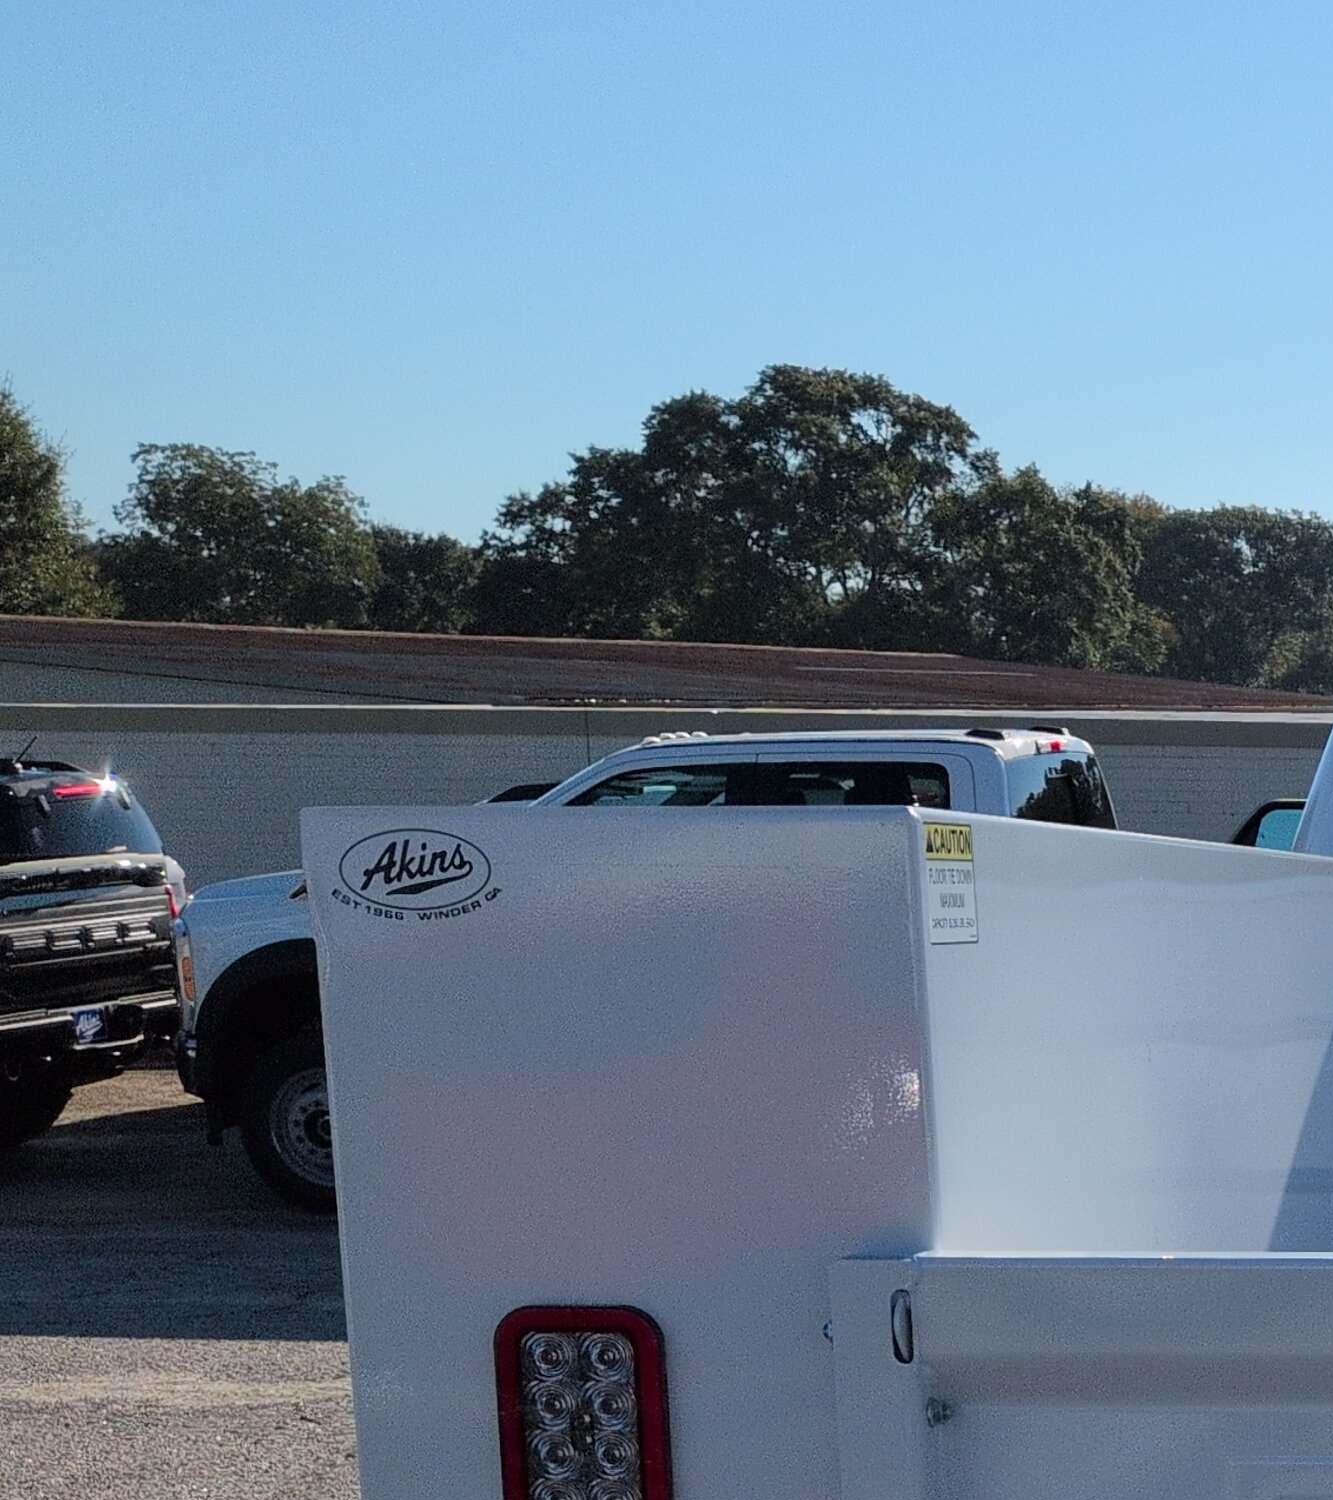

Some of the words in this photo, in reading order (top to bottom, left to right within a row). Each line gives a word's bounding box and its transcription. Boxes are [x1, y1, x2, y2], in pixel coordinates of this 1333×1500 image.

[933, 828, 971, 854] CAUTION
[361, 839, 473, 895] Akins
[331, 888, 362, 909] EST
[366, 905, 404, 921] 1966
[417, 900, 482, 921] WINDER
[484, 887, 503, 902] GA
